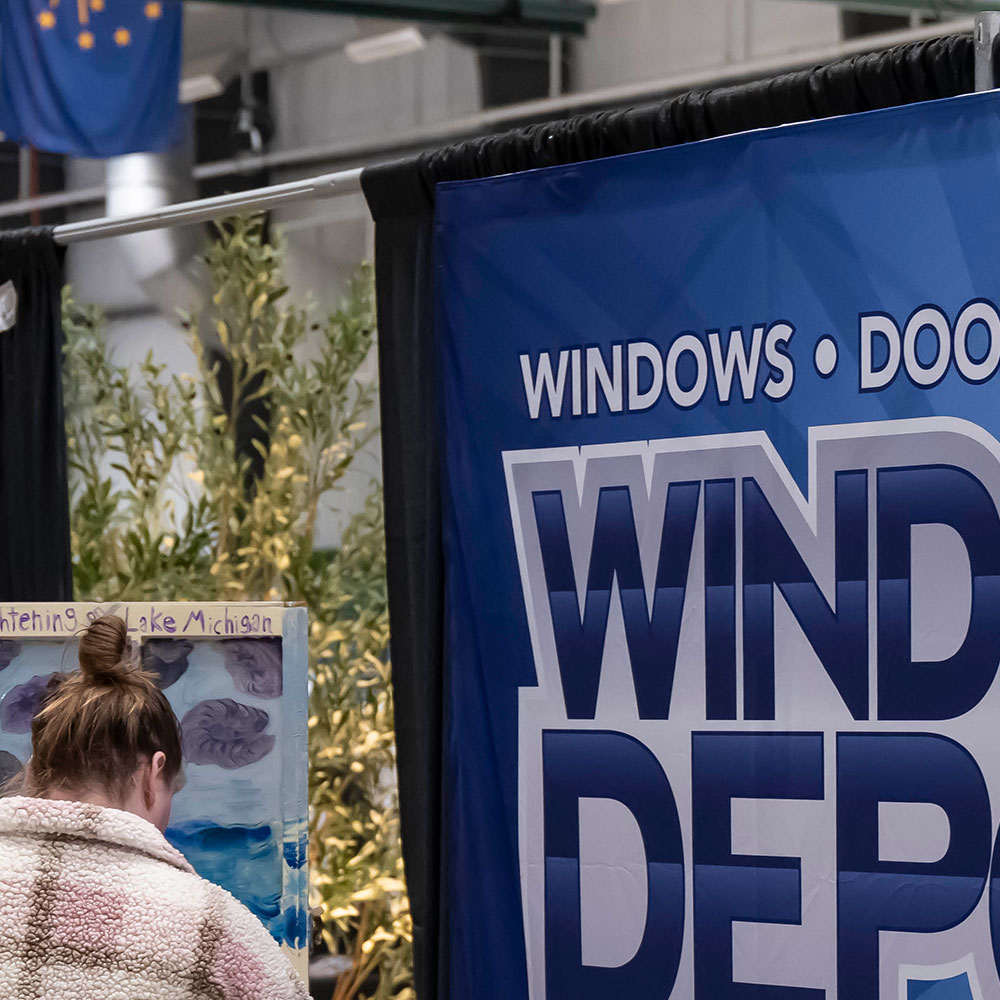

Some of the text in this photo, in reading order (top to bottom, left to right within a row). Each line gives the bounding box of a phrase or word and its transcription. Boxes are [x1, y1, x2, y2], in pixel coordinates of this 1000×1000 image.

[520, 322, 795, 420] WINDOWS
[125, 606, 177, 633] Lake
[182, 607, 273, 635] Michigan
